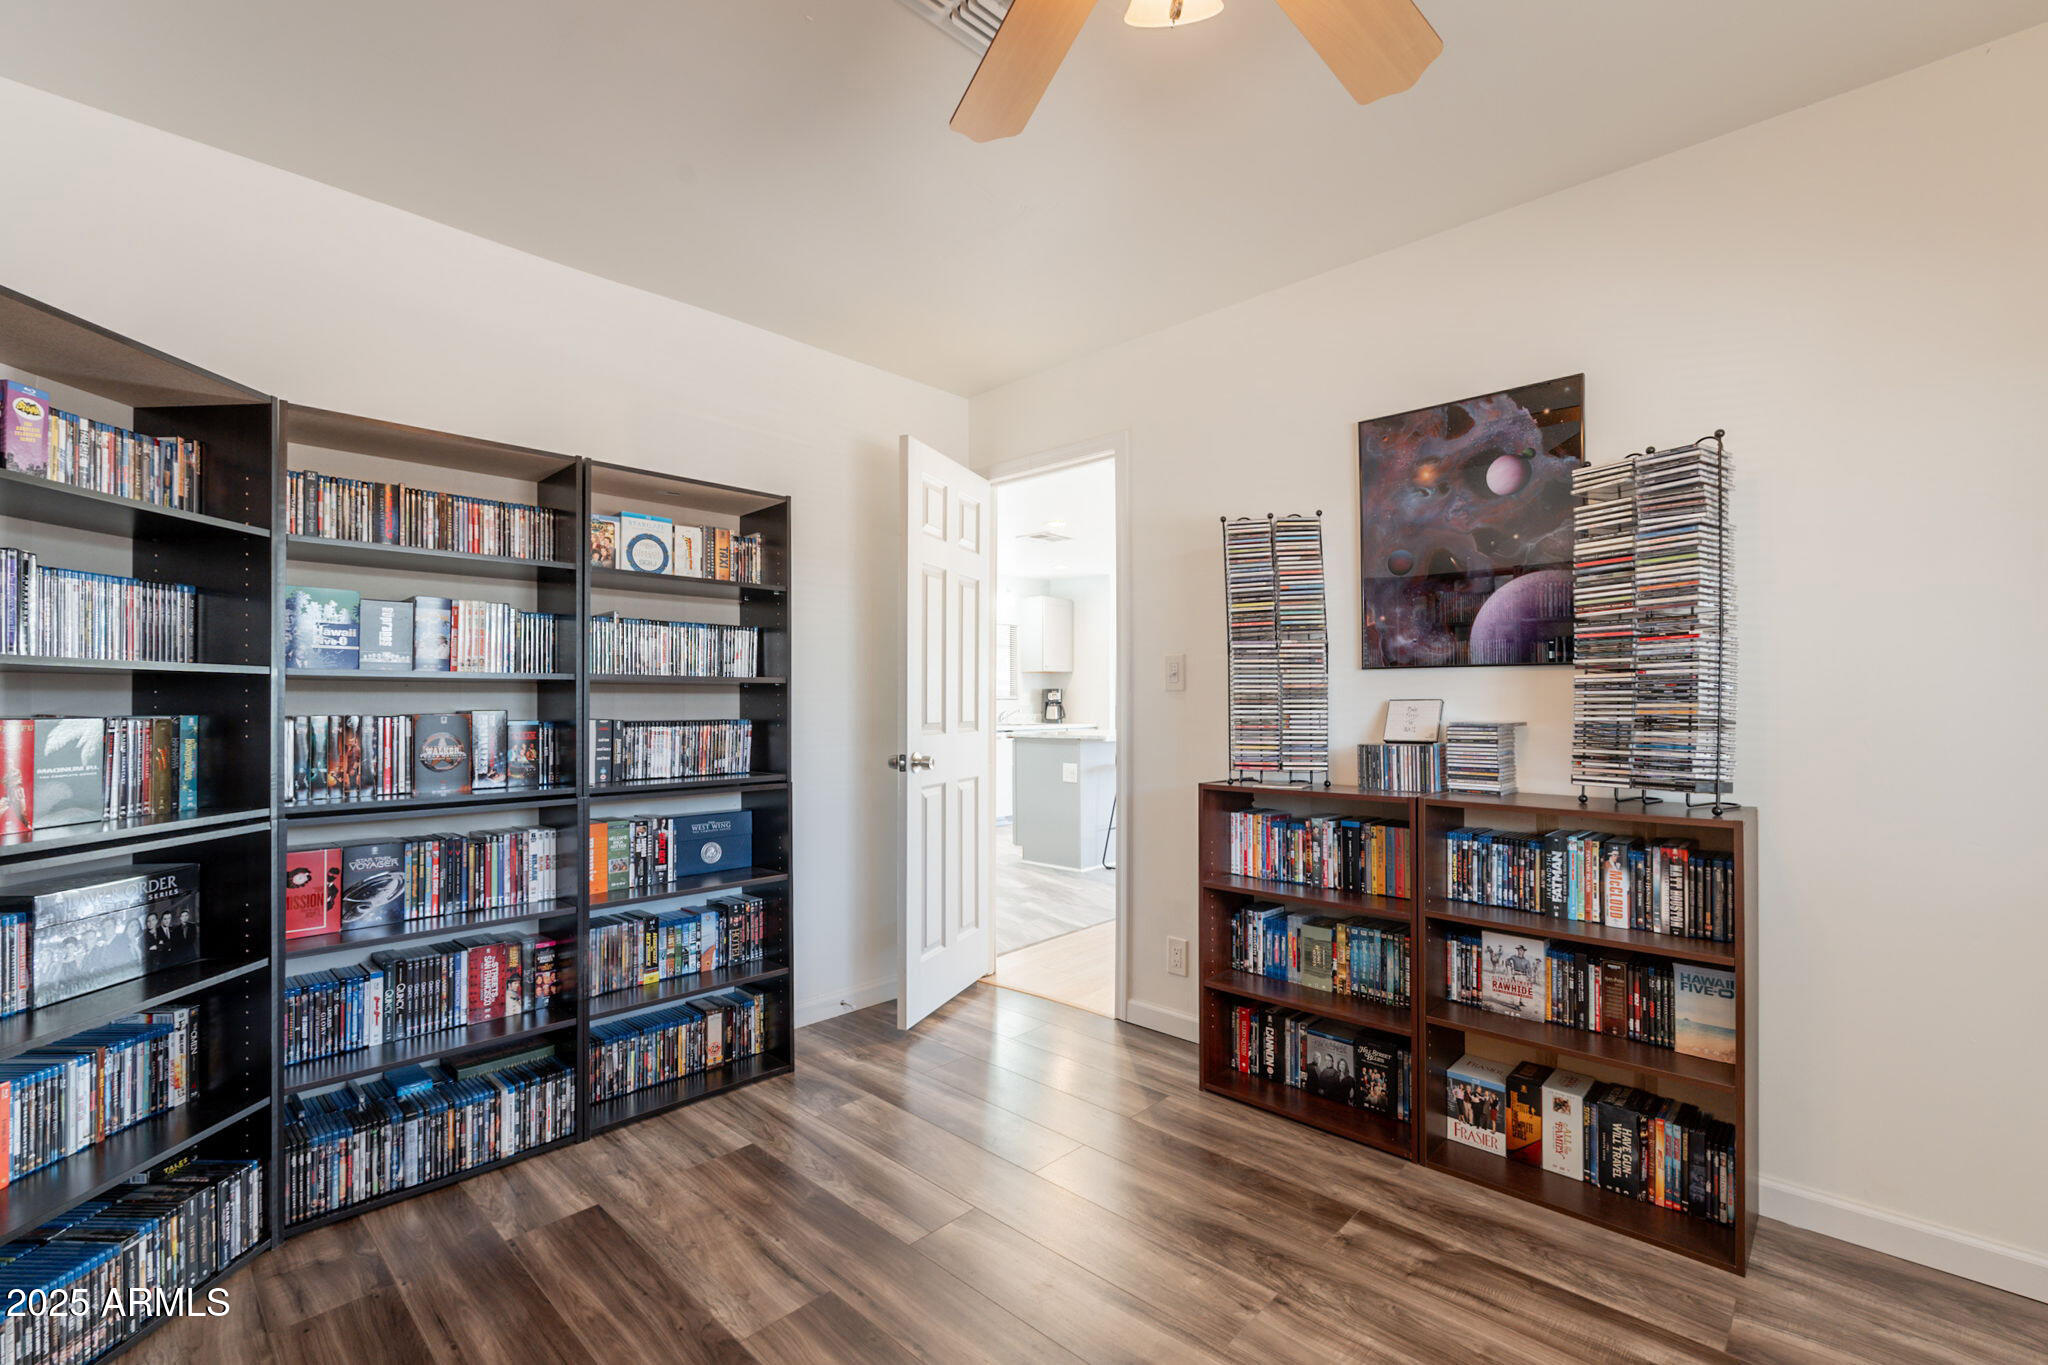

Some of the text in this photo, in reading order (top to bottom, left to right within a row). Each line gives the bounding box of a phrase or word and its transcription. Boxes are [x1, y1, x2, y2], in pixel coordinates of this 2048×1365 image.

[719, 546, 728, 568] TAXI
[711, 820, 732, 828] WING
[348, 858, 400, 871] VOYAGER
[1552, 850, 1562, 902] FATMAN
[126, 875, 178, 896] ORDER
[148, 888, 179, 900] SERIES
[1608, 870, 1623, 920] McCLOUD
[1670, 864, 1683, 928] MATT HOUSTON
[484, 956, 492, 1006] SAN FRANCISCO
[1492, 980, 1533, 996] RAWHIDE
[1680, 972, 1734, 989] HAWAII
[384, 990, 394, 1016] QUINCY
[396, 983, 405, 1010] QUINCY
[190, 1030, 198, 1054] OMEN
[1265, 1026, 1274, 1067] CANNON
[1454, 1122, 1498, 1149] FRASIER
[1612, 1123, 1622, 1178] WILL TRAVEL
[1622, 1128, 1632, 1178] HAVE GUN-
[164, 1157, 188, 1174] TALES
